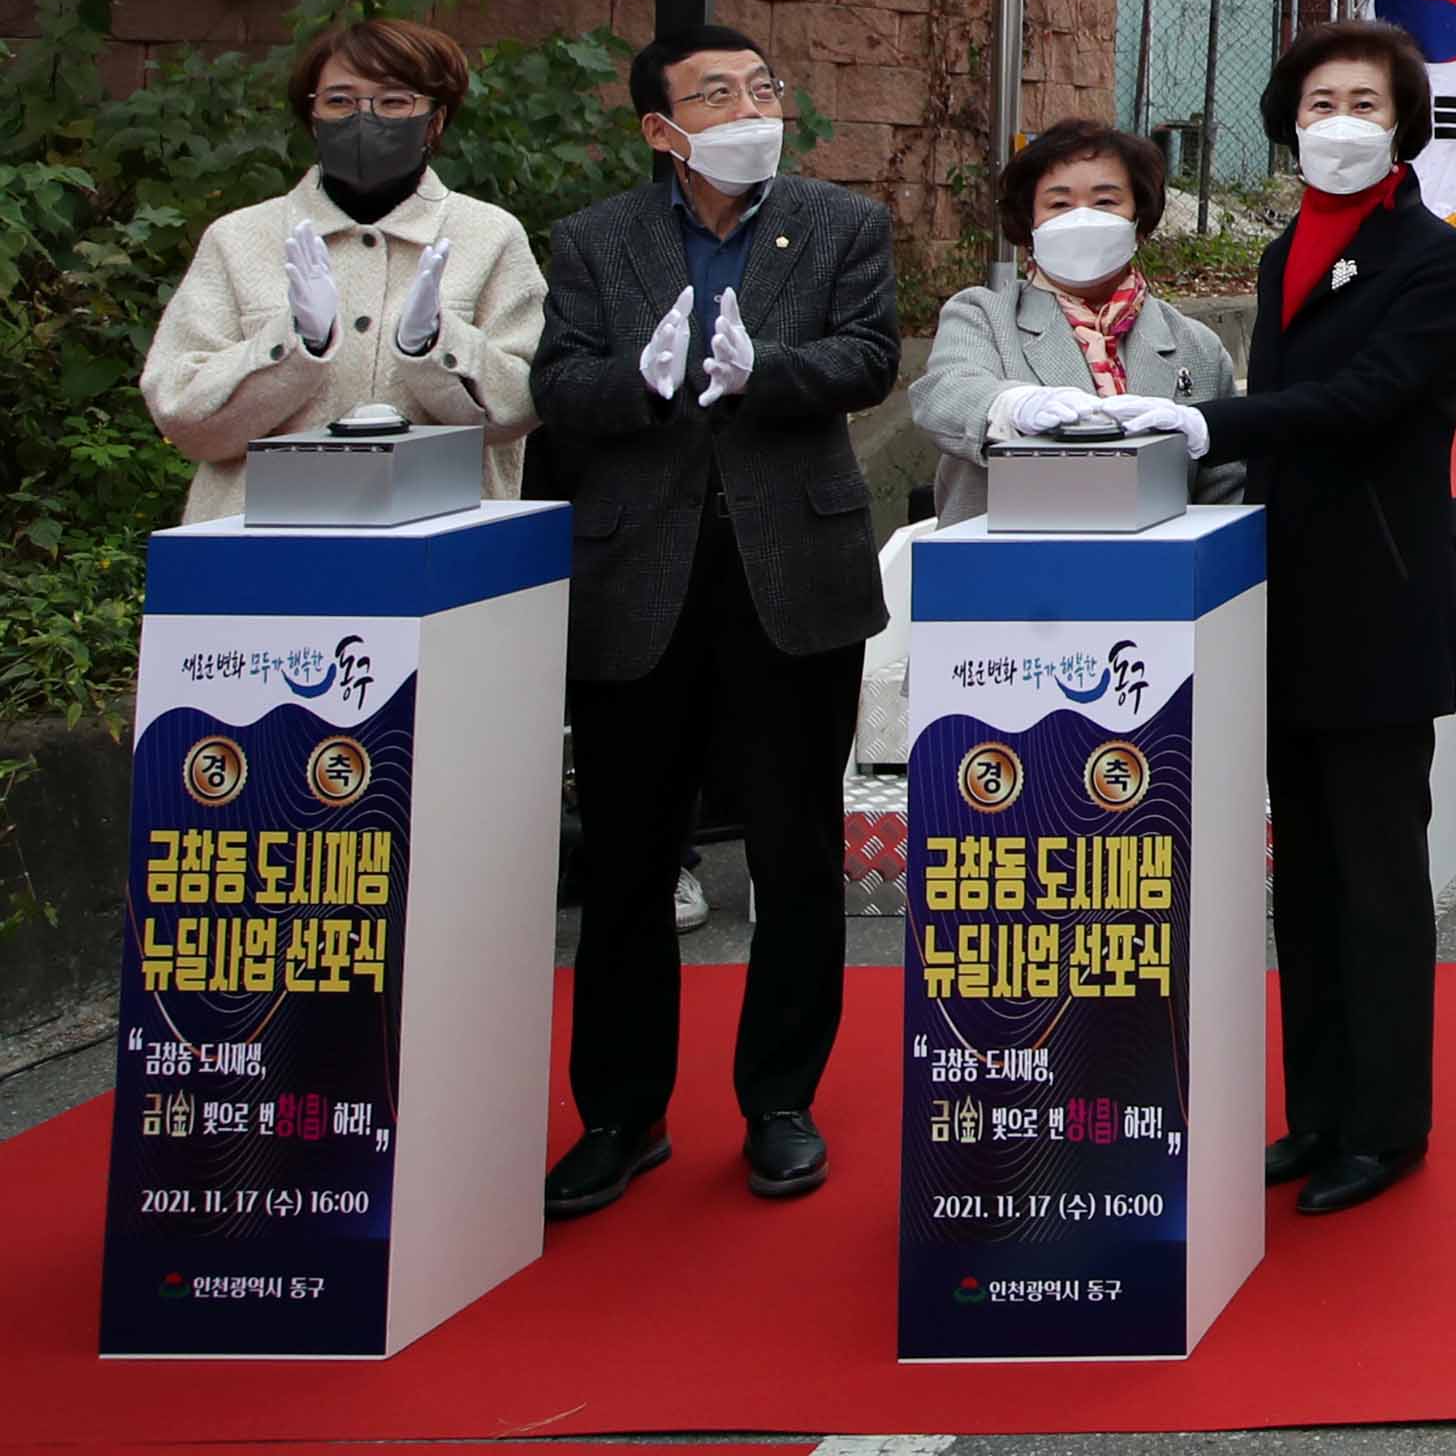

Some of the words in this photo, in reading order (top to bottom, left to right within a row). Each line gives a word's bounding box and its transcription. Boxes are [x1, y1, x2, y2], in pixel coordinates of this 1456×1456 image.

[201, 755, 227, 788] 경
[326, 753, 354, 786] 축
[977, 762, 1002, 794] 경
[1103, 759, 1131, 792] 축
[145, 828, 249, 904] 금창동
[255, 829, 391, 905] 도시재생
[925, 835, 1027, 910] 금창동
[1036, 835, 1172, 910] 도시재생
[141, 916, 277, 993] 뉴딜사업
[284, 917, 387, 993] 선포식
[923, 923, 1059, 999] 뉴딜사업
[1069, 923, 1171, 997] 선포식
[992, 1107, 1039, 1141] 빛으로
[236, 1190, 258, 1214] 17
[265, 1188, 302, 1217] (수)
[309, 1191, 369, 1215] 16:00
[933, 1195, 988, 1219] 2021.
[997, 1195, 1020, 1218] 11.
[1029, 1195, 1051, 1218] 17
[1059, 1192, 1095, 1221] (수)
[1103, 1194, 1163, 1218] 16:00
[193, 1275, 283, 1300] 인천광역시
[289, 1277, 325, 1300] 동구
[989, 1280, 1079, 1303] 인천광역시
[1086, 1281, 1122, 1303] 동구
